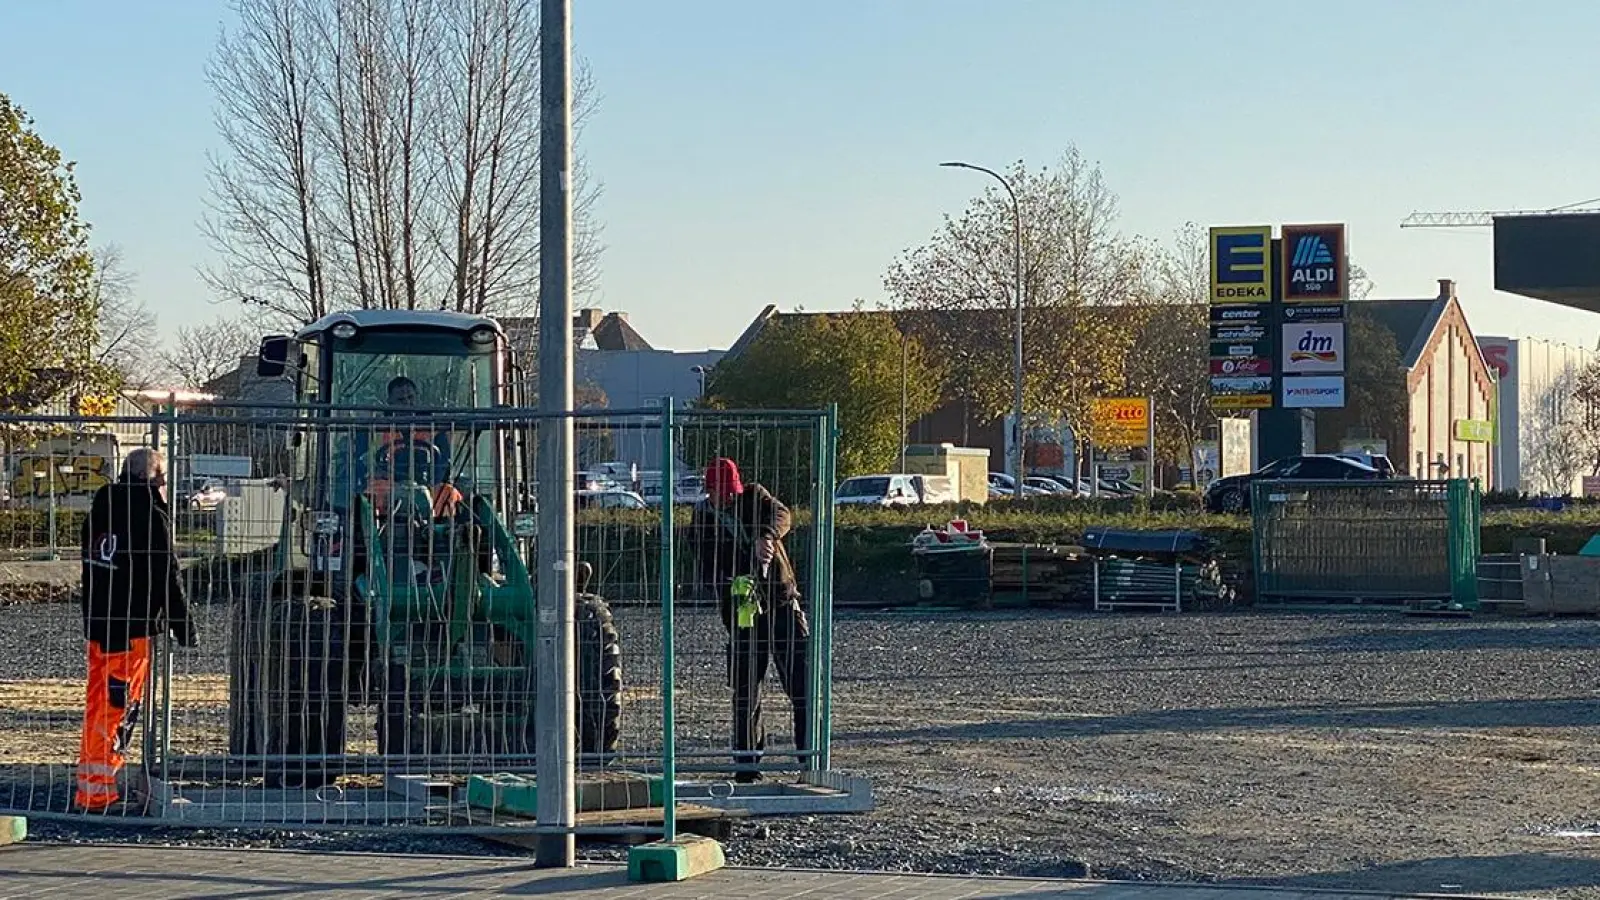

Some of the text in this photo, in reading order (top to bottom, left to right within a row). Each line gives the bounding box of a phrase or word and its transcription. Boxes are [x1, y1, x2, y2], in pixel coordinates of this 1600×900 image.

[1291, 268, 1334, 282] ALDI
[1216, 287, 1266, 298] EDEKA
[1298, 330, 1333, 351] dm
